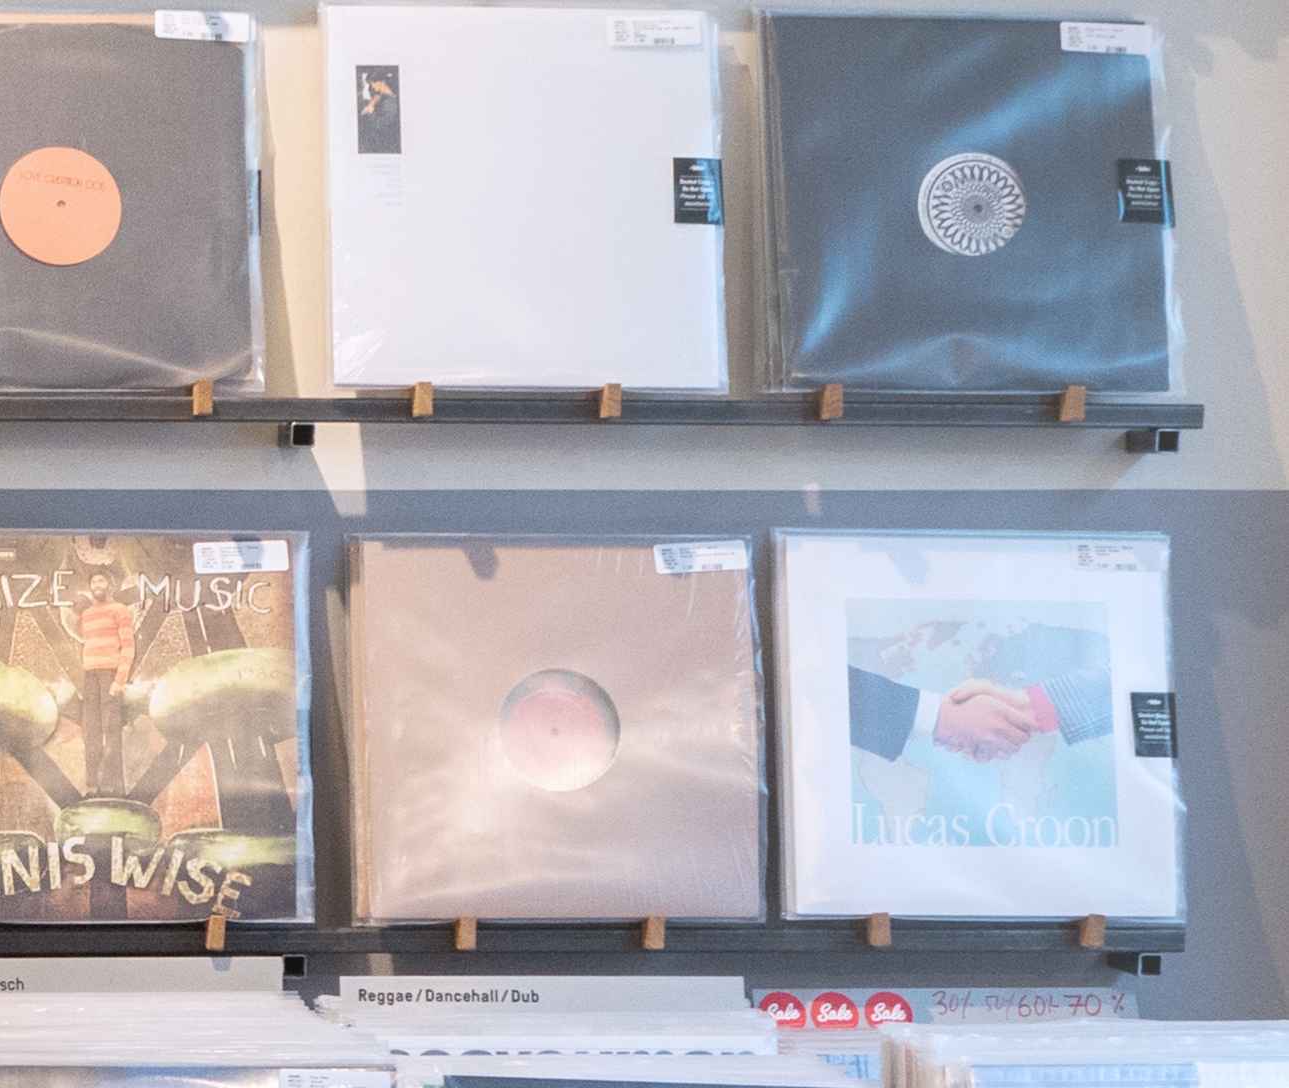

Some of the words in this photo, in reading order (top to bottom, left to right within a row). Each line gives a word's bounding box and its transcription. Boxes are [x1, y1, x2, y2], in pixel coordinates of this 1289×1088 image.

[138, 571, 273, 614] MUSIC
[852, 802, 970, 848] Lucas
[985, 803, 1118, 849] Croon
[110, 835, 253, 919] WISE
[766, 1002, 802, 1022] Sale
[816, 1002, 854, 1023] Sale
[870, 1002, 907, 1022] Sale
